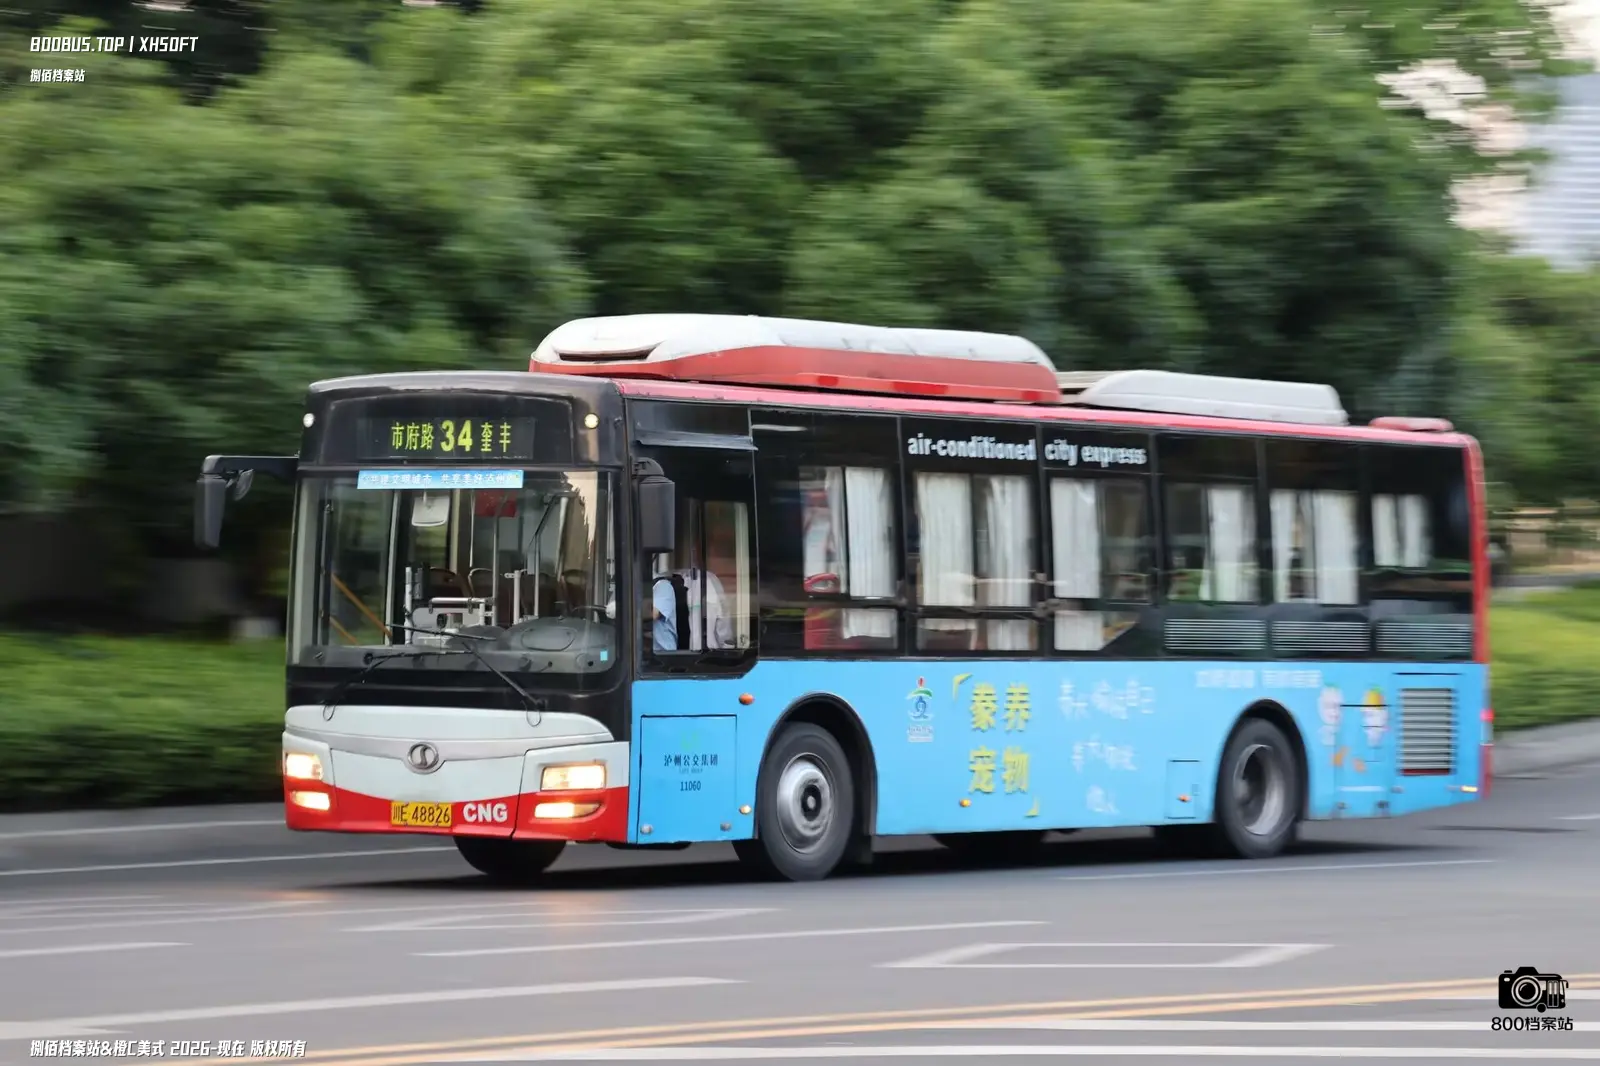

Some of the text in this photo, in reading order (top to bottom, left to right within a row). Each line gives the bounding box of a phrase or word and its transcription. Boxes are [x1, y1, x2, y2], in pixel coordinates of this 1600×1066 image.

[391, 420, 512, 452] 市府路 34 奎丰
[907, 433, 1147, 467] air-conditioned city express
[680, 780, 702, 792] 11060
[968, 745, 1030, 795] 宠物
[462, 803, 508, 823] CNG
